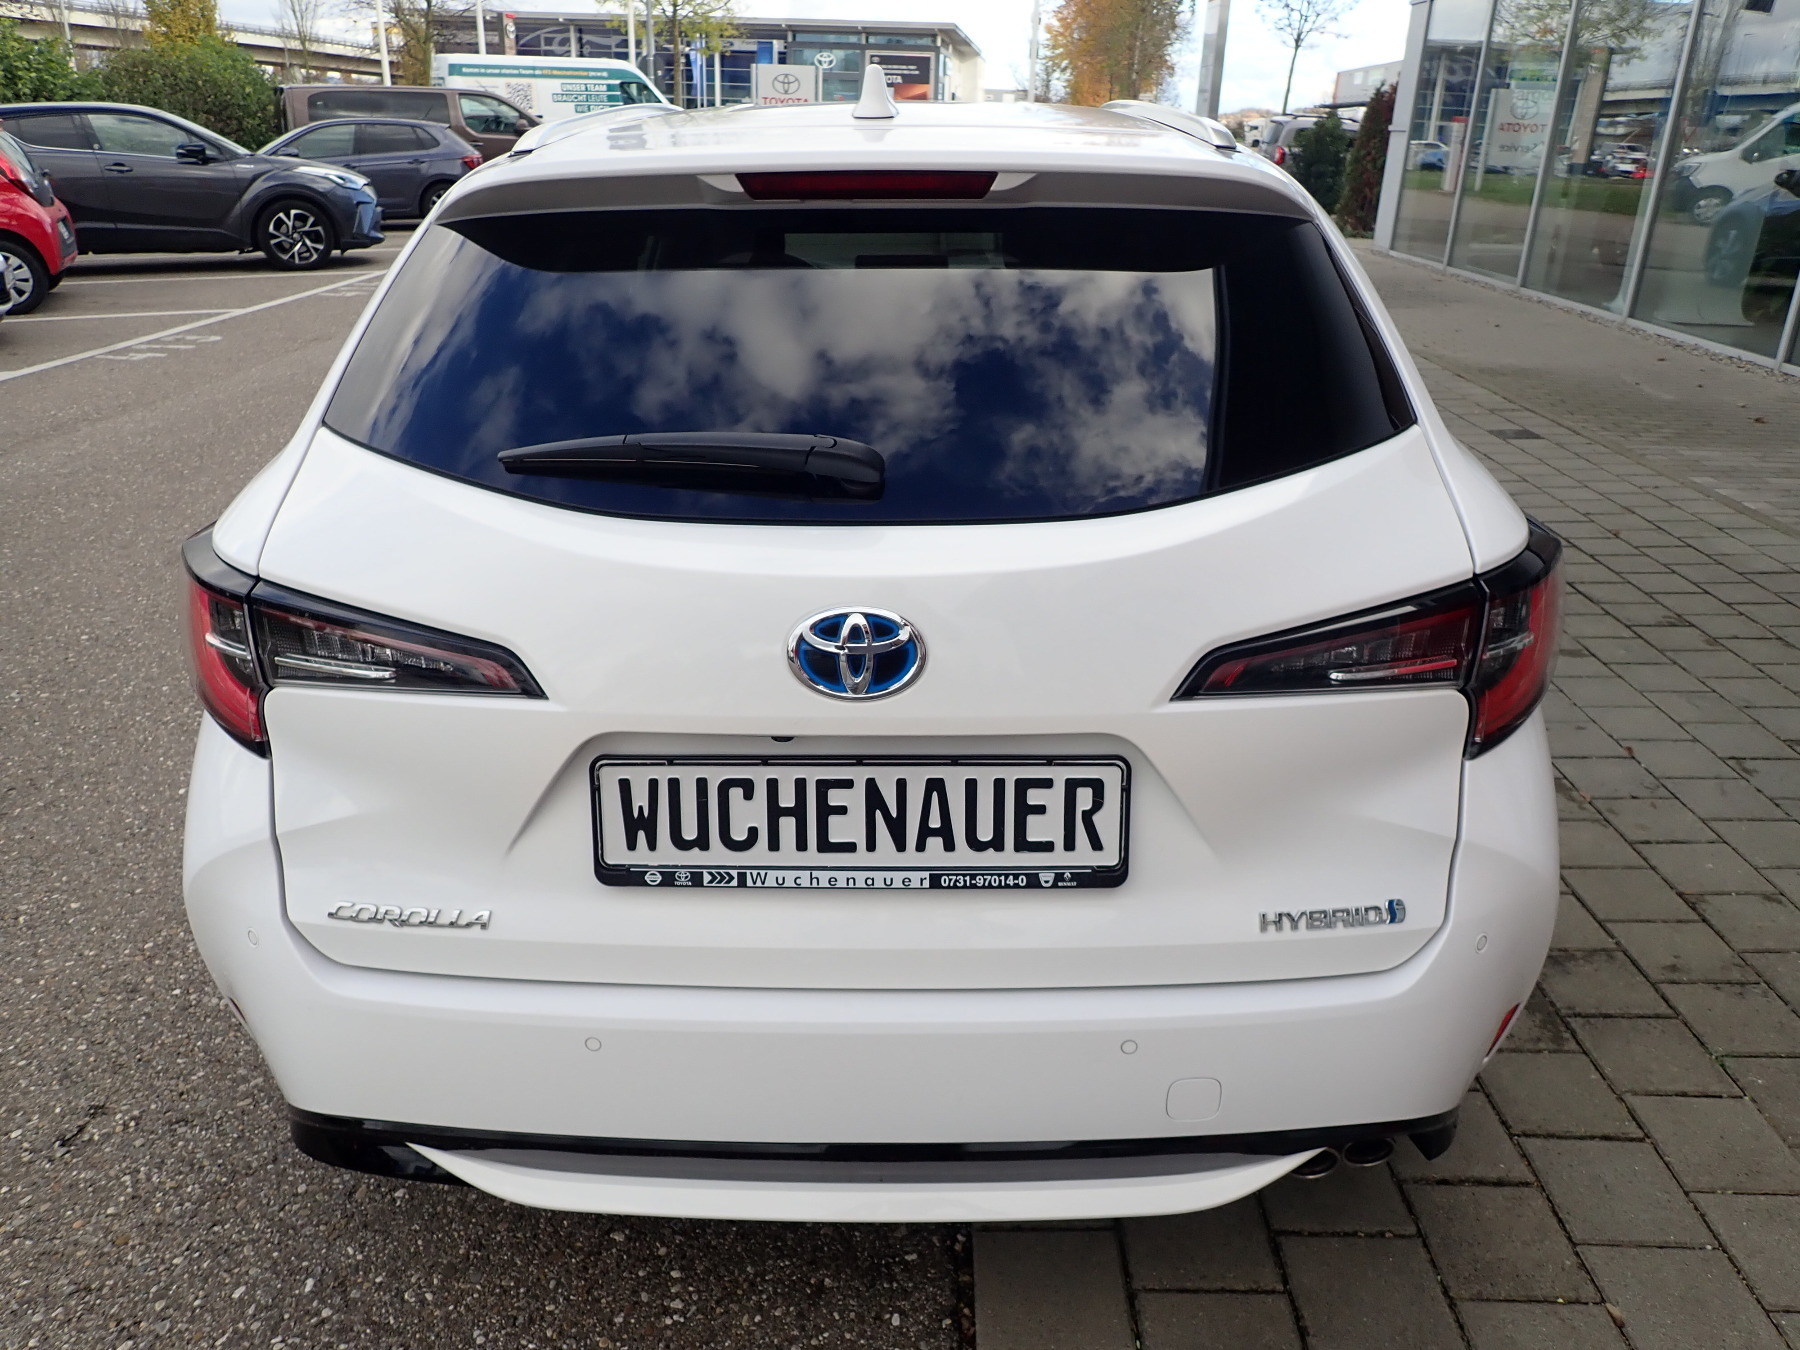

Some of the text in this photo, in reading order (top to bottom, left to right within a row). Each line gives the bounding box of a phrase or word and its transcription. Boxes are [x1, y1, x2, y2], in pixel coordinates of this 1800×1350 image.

[561, 83, 608, 92] UNSER TEAM
[552, 94, 608, 102] BRAUCHT LEUTE
[575, 104, 589, 112] WIE
[617, 777, 1105, 853] WUCHENAUER
[749, 872, 928, 887] Wuchenauer
[940, 876, 1027, 887] 0731-97014-0
[327, 900, 493, 930] COROLLA
[1258, 905, 1384, 933] HYBRID
